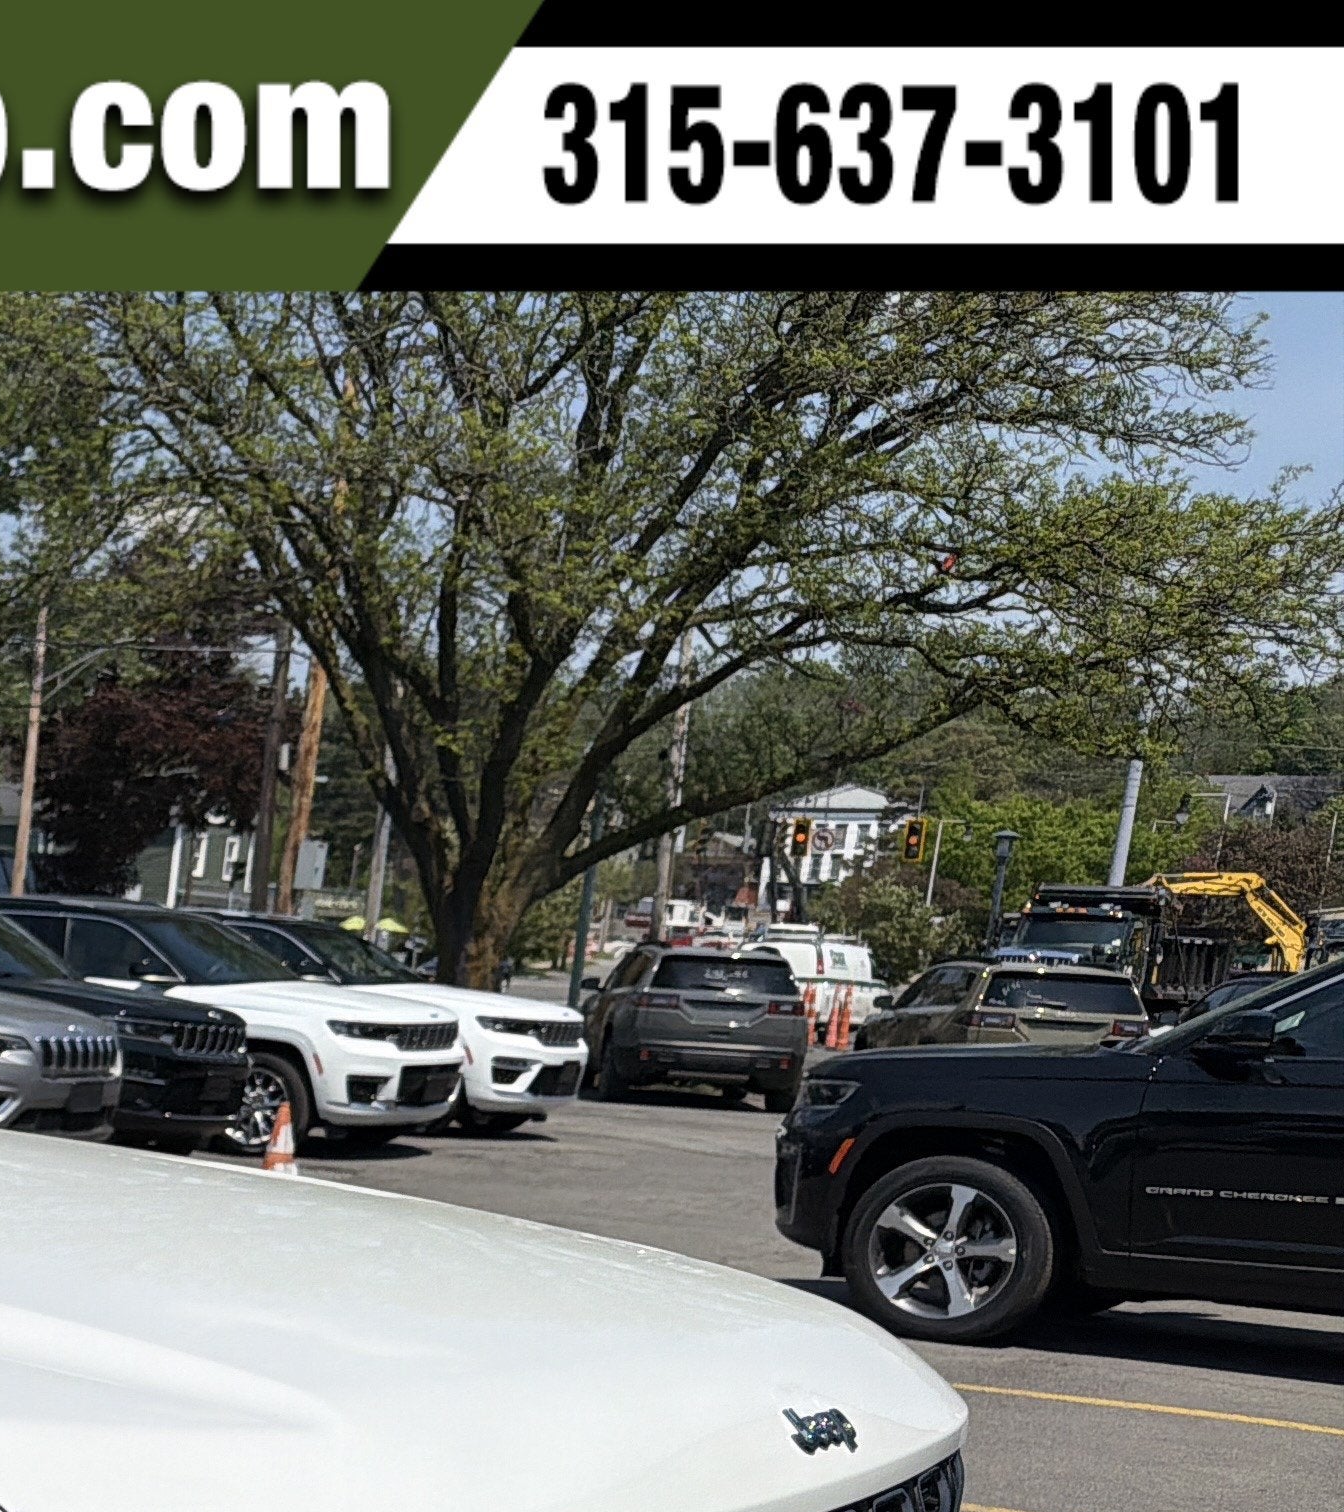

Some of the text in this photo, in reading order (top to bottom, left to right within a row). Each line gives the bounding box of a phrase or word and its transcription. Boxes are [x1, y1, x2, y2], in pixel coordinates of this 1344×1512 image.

[1145, 1186, 1330, 1205] GRAND CHEROKEE
[782, 1408, 858, 1456] Jeep
